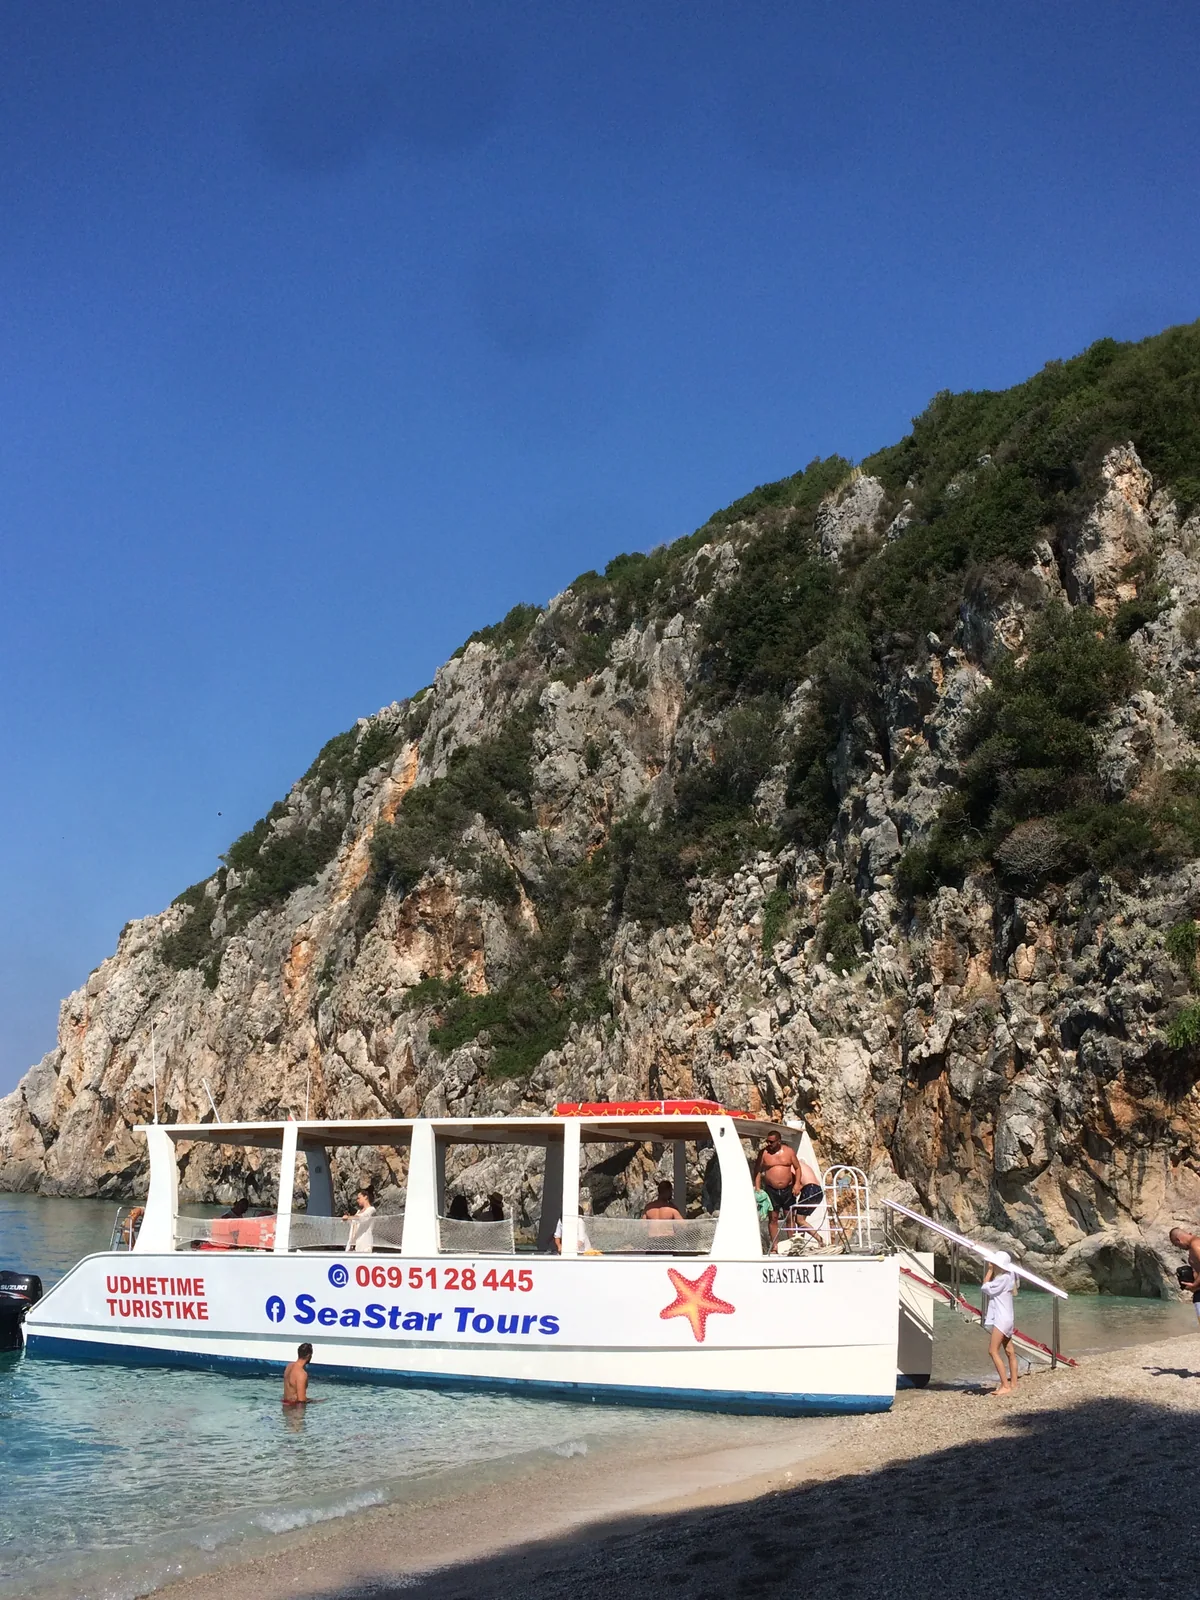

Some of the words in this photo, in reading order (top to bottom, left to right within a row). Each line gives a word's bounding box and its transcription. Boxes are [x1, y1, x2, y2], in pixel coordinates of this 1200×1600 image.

[355, 1265, 402, 1288] 069
[482, 1269, 534, 1292] 445
[762, 1268, 810, 1283] SEASTAR
[813, 1264, 824, 1283] II
[106, 1275, 205, 1296] UDHETIME
[106, 1298, 209, 1320] TURISTIKE
[293, 1293, 442, 1332] SeaStar
[454, 1306, 560, 1335] Tours
